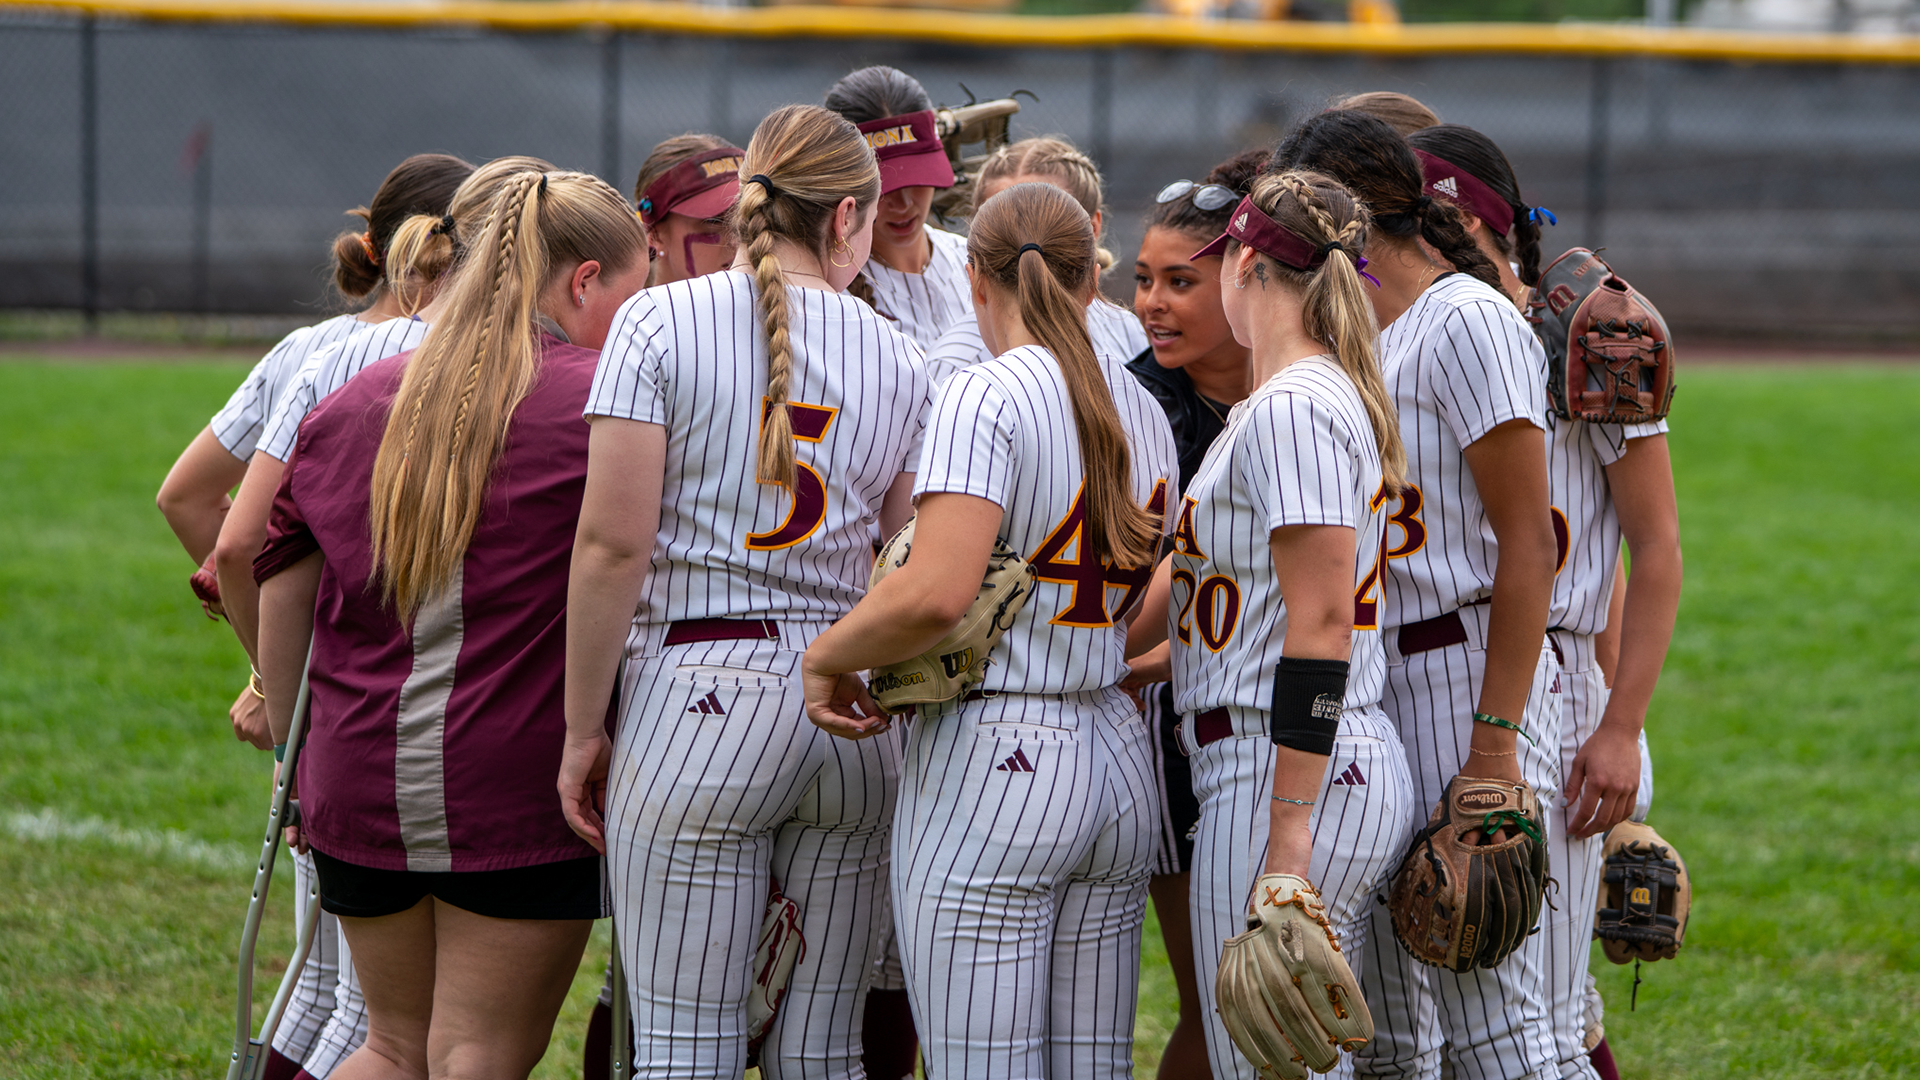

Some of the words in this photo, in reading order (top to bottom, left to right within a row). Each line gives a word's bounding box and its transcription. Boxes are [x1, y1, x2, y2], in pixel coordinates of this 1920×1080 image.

[864, 124, 918, 149] IONA
[744, 395, 839, 551] 5
[1171, 568, 1241, 653] 20
[940, 647, 973, 679] W
[875, 671, 926, 694] Wilson
[1462, 793, 1503, 804] Wilson
[1460, 924, 1477, 958] A2000
